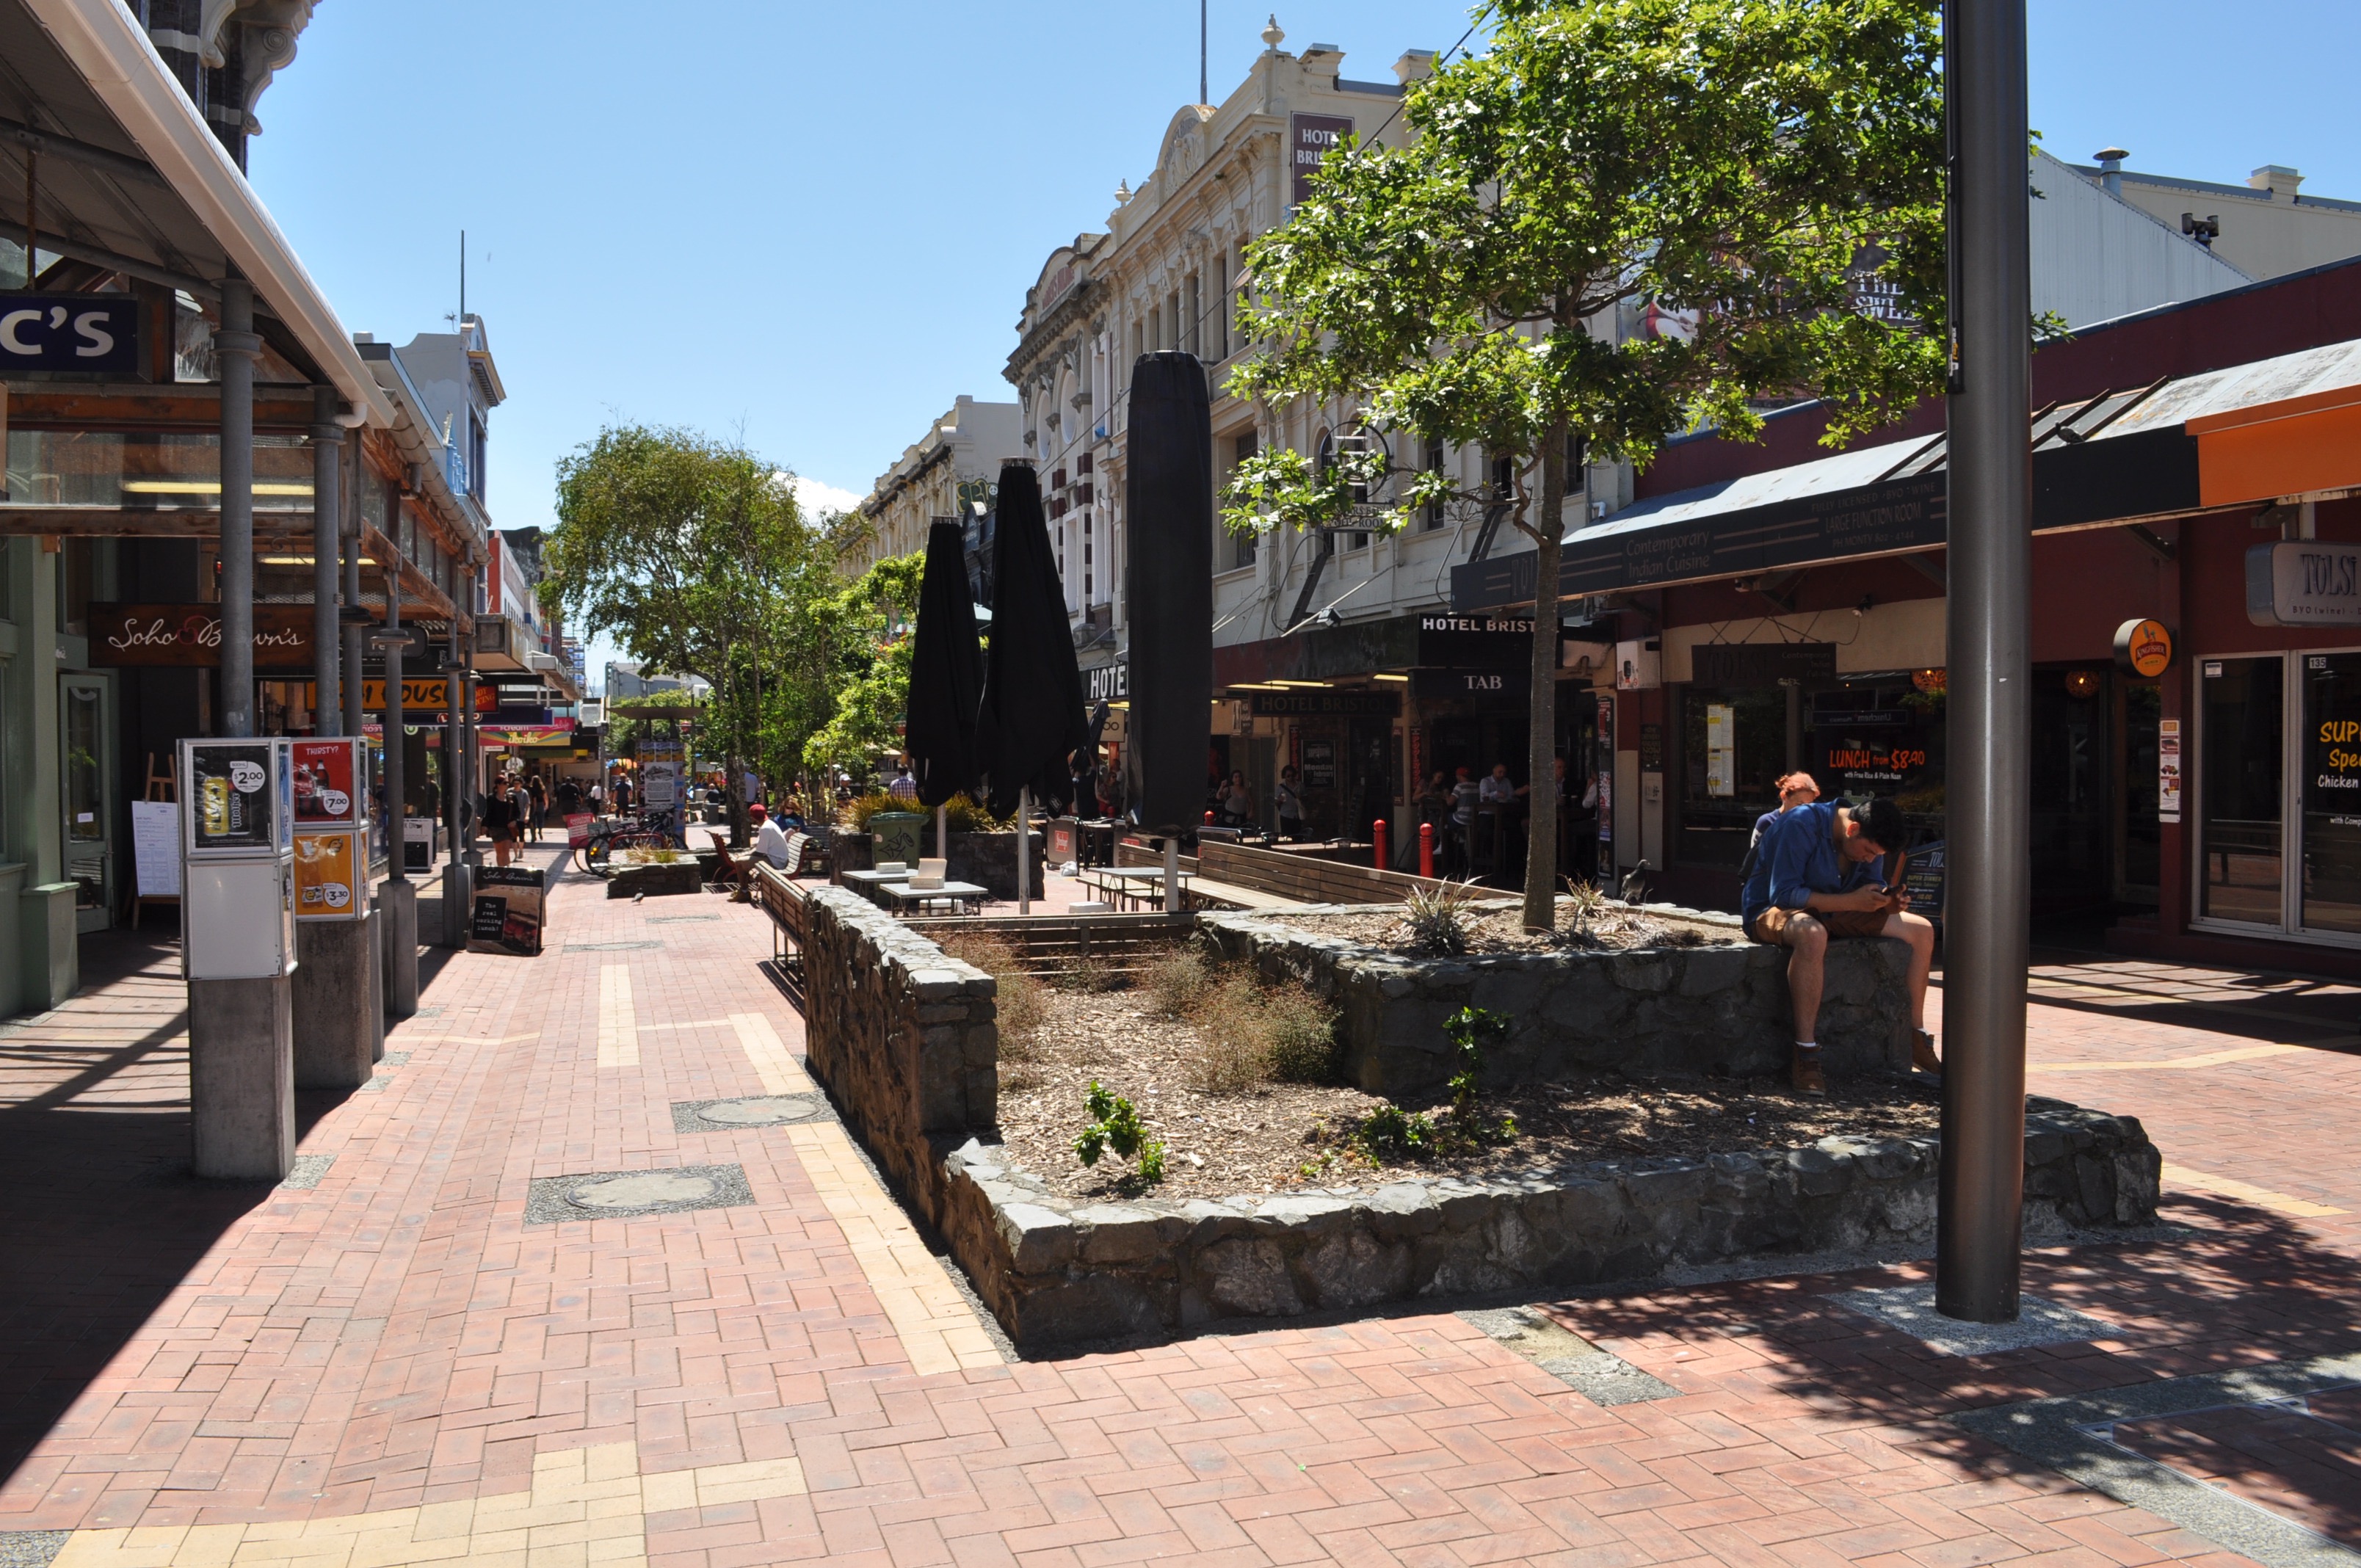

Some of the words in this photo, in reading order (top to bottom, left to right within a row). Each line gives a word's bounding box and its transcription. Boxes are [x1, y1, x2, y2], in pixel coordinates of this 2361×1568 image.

[1302, 128, 1341, 146] HOTE
[1811, 501, 1835, 512] FULLY
[1838, 493, 1879, 509] LICENSED
[1910, 482, 1936, 496] WINE
[1825, 512, 1852, 534] LARGE
[1852, 505, 1893, 528] FUNCTION
[1894, 501, 1922, 523] ROOM
[1626, 530, 1710, 557] Contemporary
[1628, 561, 1664, 579] Indian
[1666, 551, 1710, 573] Cuisine
[1422, 617, 1481, 631] HOTEL
[1486, 619, 1559, 633] BRIST
[108, 618, 178, 652] Soho
[197, 617, 305, 647] Bwn's
[2311, 658, 2326, 667] 135
[1463, 675, 1503, 690] TAB
[382, 683, 449, 703] OUS
[1261, 696, 1317, 711] HOTEL
[1322, 696, 1391, 711] BRISTOL
[305, 745, 339, 755] THIRSTY?
[1829, 749, 1871, 769] LUNCH
[1873, 755, 1890, 766] from
[1891, 748, 1926, 771] $8.90
[234, 772, 264, 785] $2.00
[1879, 772, 1890, 780] Plain
[2318, 774, 2359, 788] Chicken
[325, 798, 347, 808] $7.00
[2329, 816, 2343, 824] with
[326, 890, 348, 901] $3.30
[475, 917, 502, 925] working
